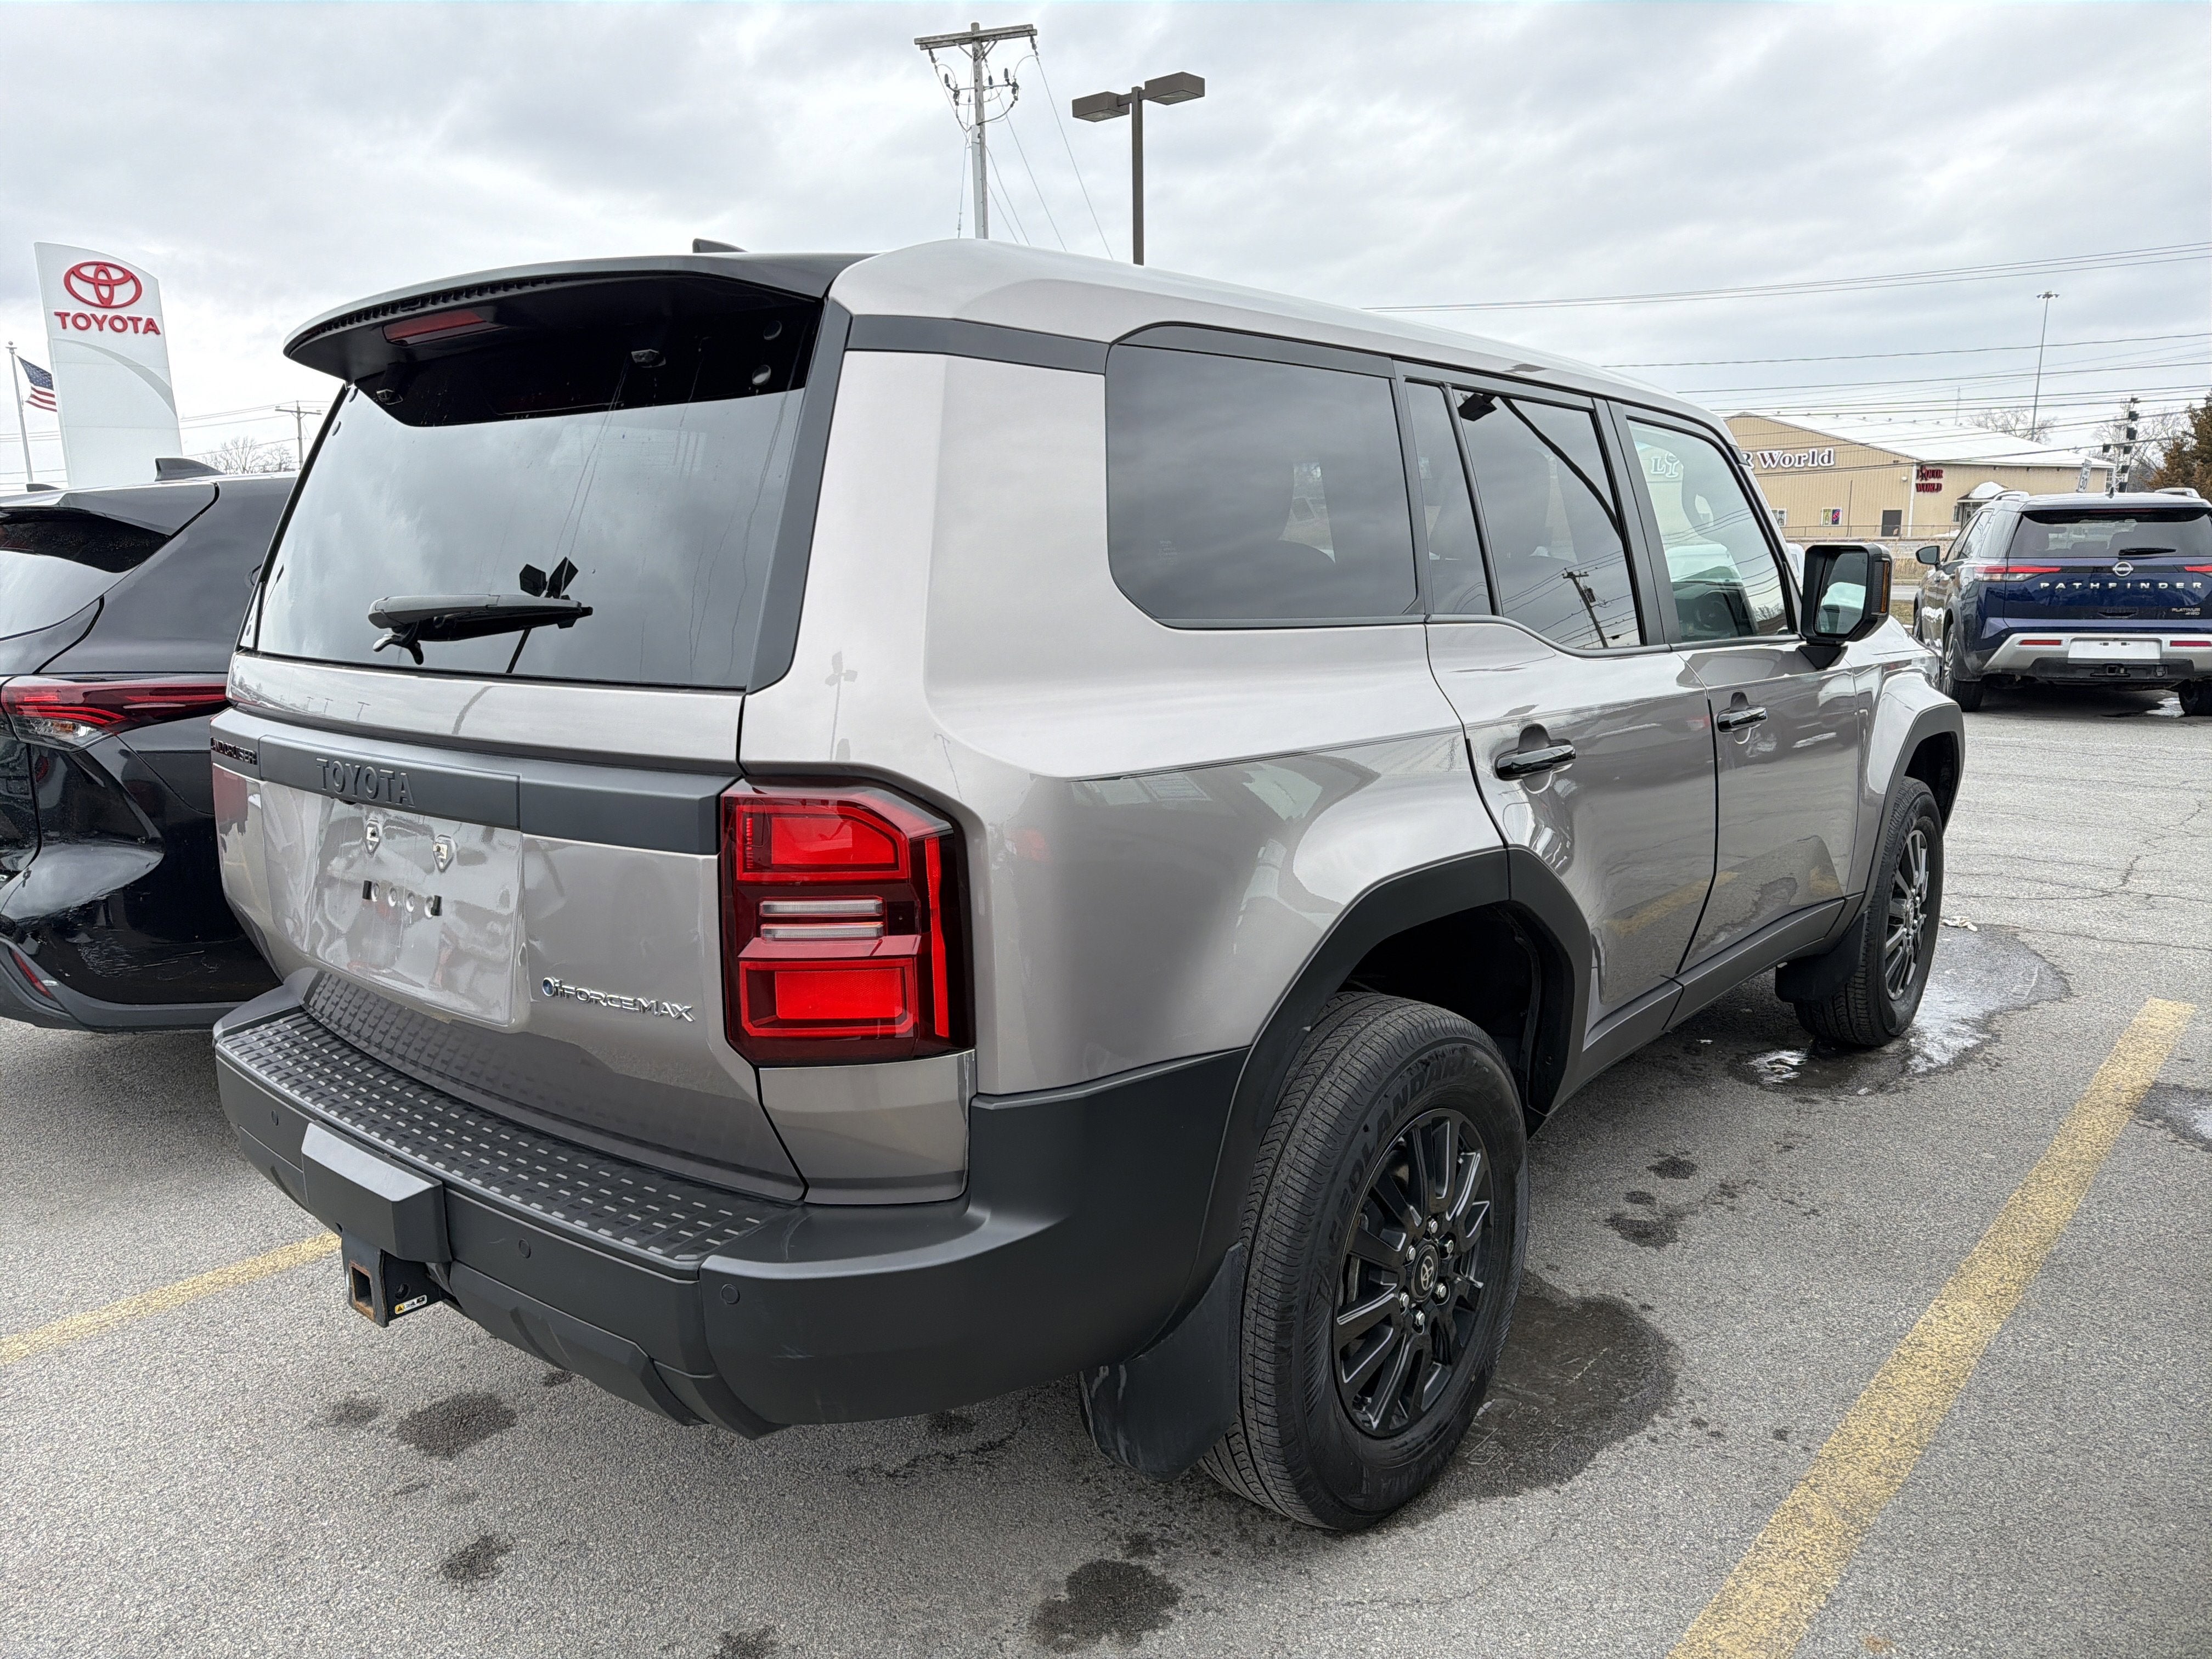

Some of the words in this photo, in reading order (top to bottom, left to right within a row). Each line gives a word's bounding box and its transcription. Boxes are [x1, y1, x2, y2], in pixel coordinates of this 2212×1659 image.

[54, 312, 161, 335] TOYOTA
[1757, 448, 1835, 469] World
[1915, 483, 1943, 493] WORLD
[2080, 476, 2088, 490] 30
[316, 757, 416, 808] TOYOTA
